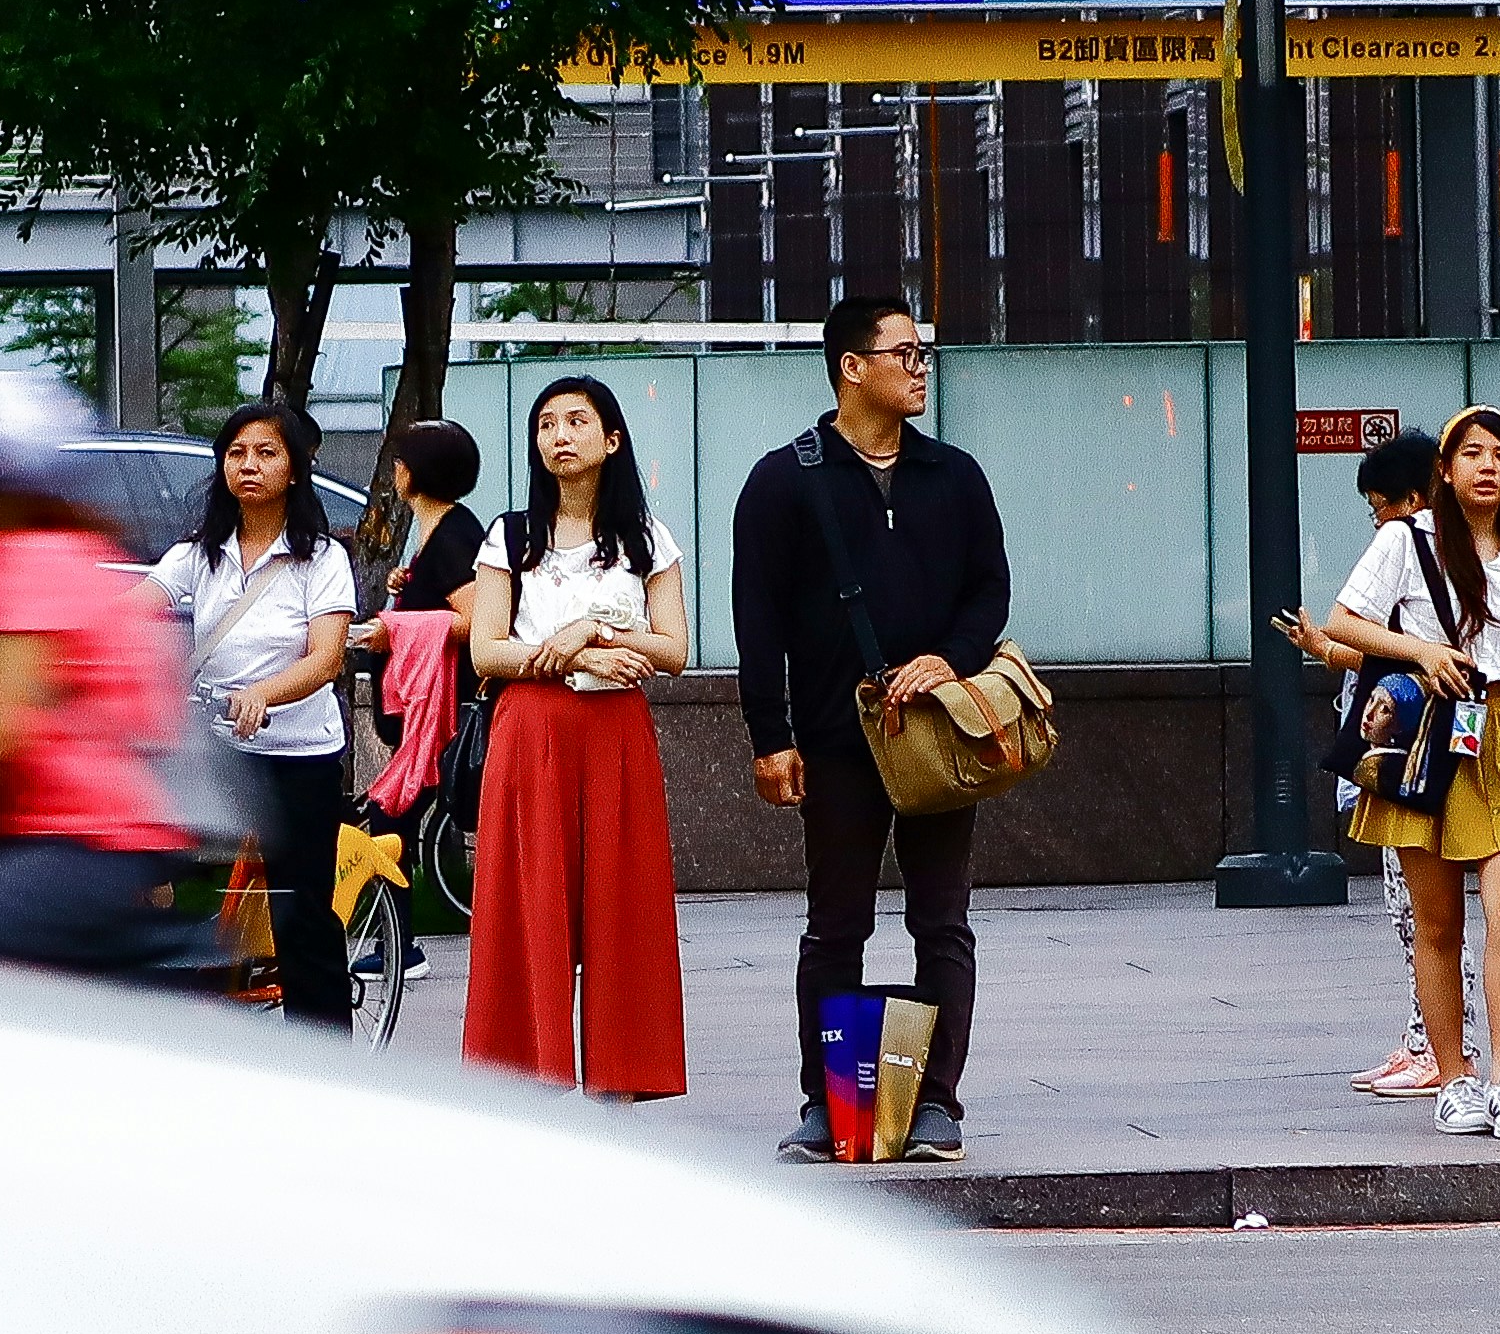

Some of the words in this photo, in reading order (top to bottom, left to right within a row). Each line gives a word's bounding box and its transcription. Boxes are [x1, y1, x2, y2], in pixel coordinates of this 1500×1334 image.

[743, 40, 806, 65] 1.9M
[1322, 36, 1461, 59] Clearance
[1296, 417, 1353, 433] 勿攀爬
[1301, 435, 1322, 446] NOT
